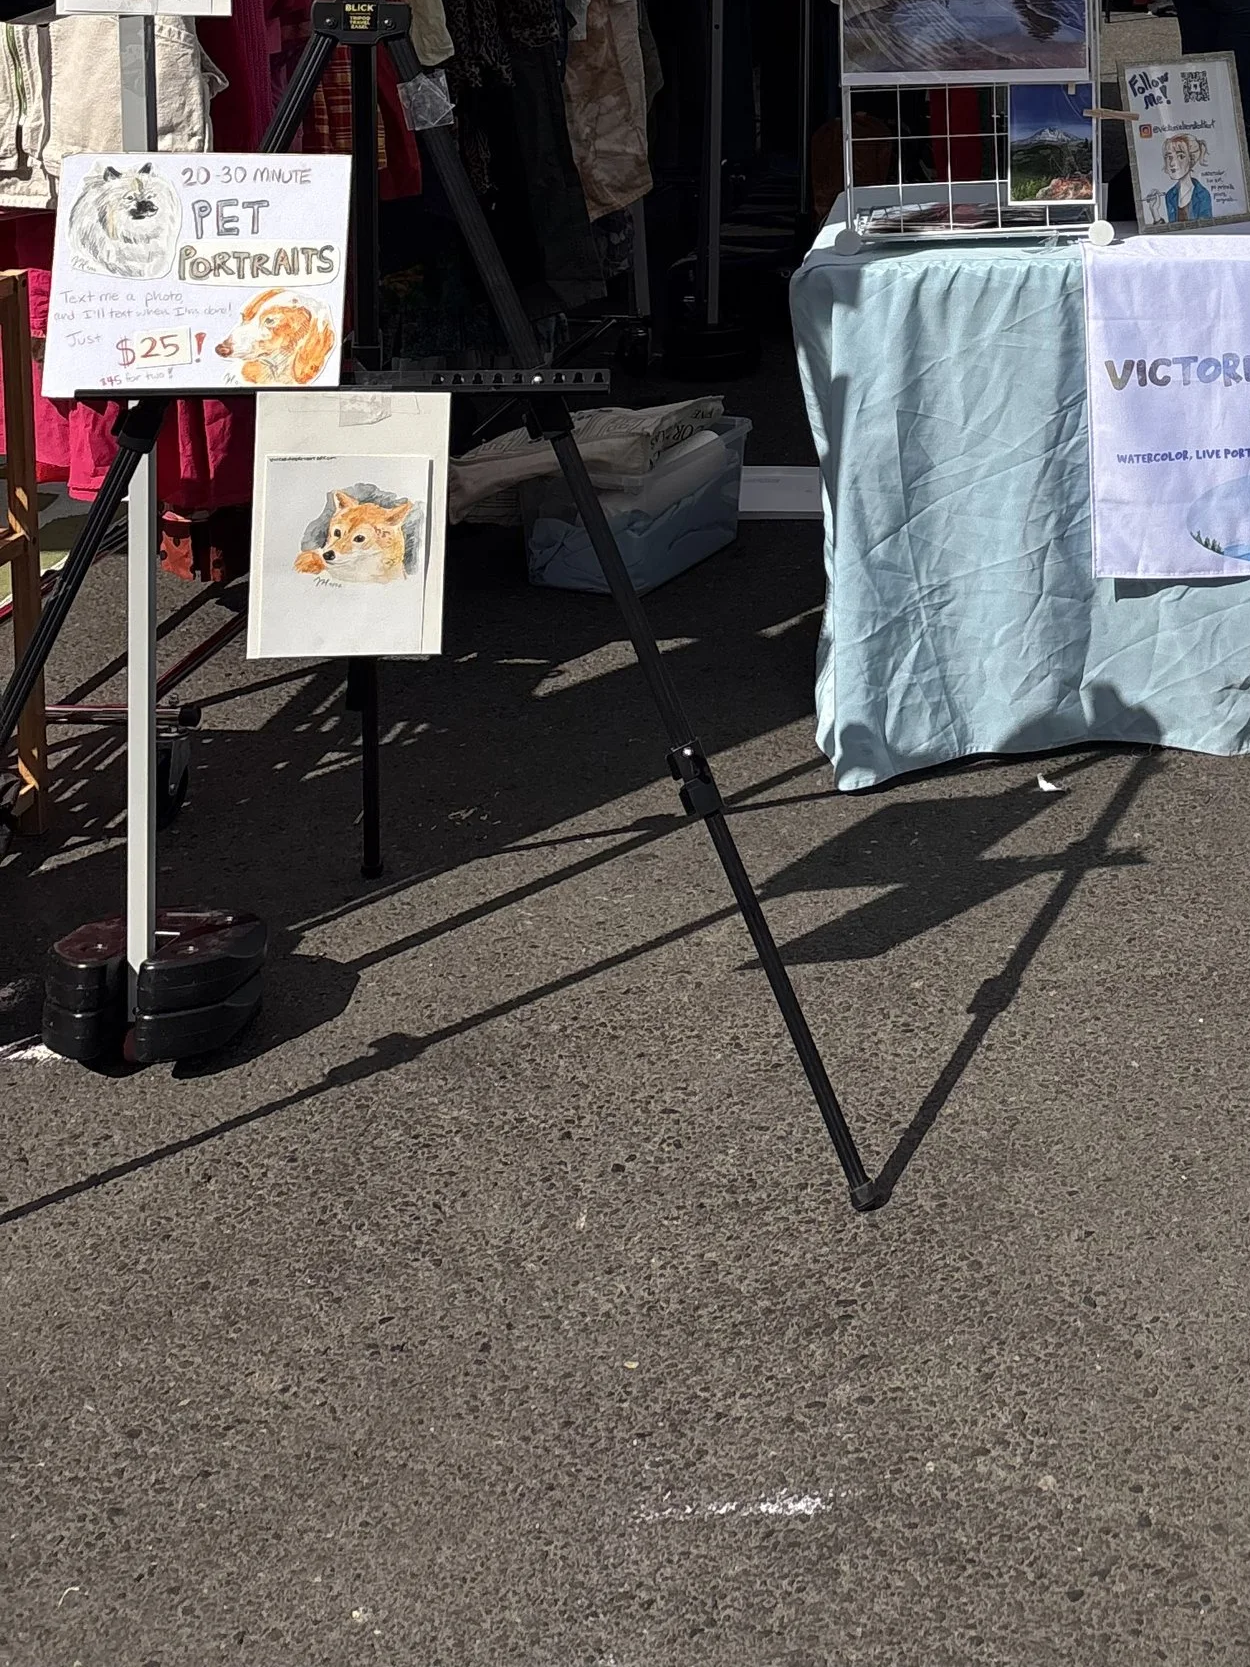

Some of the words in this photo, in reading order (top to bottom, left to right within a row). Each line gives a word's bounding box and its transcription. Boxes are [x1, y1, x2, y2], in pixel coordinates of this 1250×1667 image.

[345, 4, 375, 12] BLICK
[1128, 71, 1169, 97] Follow
[1144, 85, 1171, 109] Me!
[192, 199, 269, 239] PET
[178, 245, 334, 280] PORTRAITS
[60, 290, 95, 304] Text
[99, 292, 119, 302] me
[54, 309, 75, 320] and
[110, 307, 131, 319] text
[66, 330, 103, 347] Just
[1117, 450, 1193, 464] WATERCOLOR,
[1196, 449, 1221, 460] LIVE
